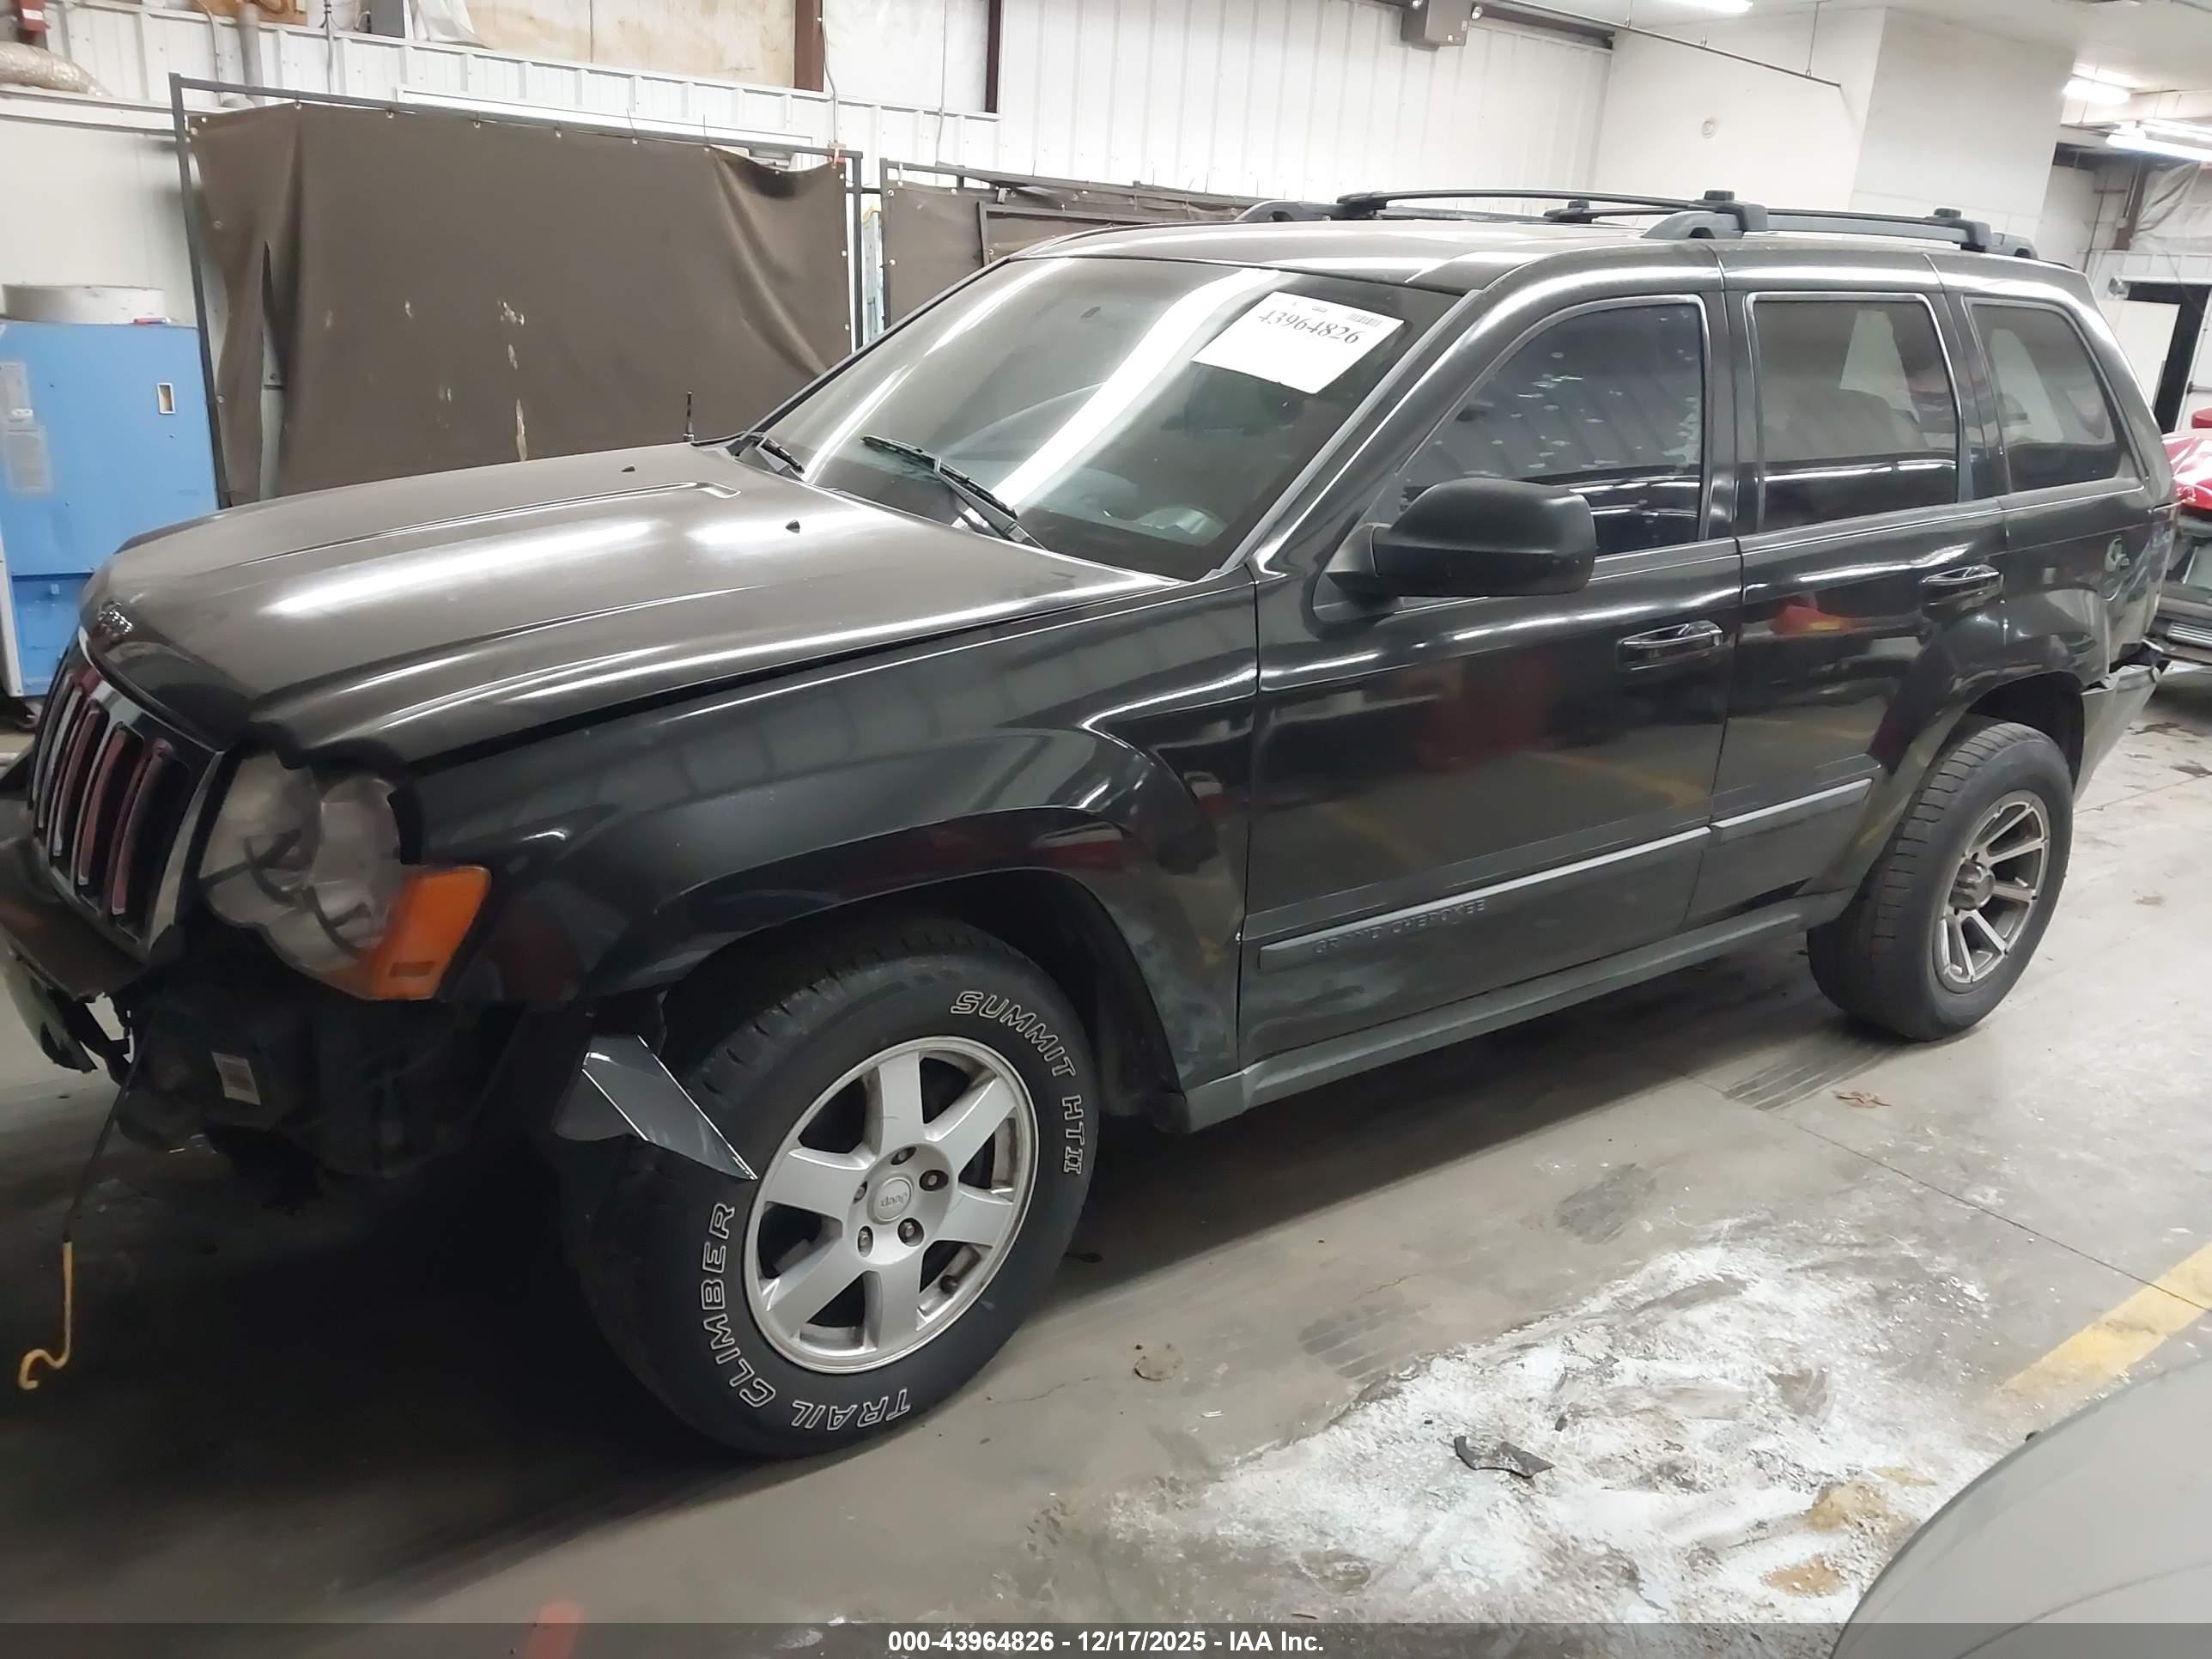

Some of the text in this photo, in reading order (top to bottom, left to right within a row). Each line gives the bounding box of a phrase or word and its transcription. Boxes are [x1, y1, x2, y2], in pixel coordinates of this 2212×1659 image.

[1258, 310, 1367, 343] 43964826
[1315, 926, 1383, 954] GRD
[950, 990, 1076, 1077] SUMMIT
[701, 1202, 911, 1431] TRAIL CLIMBER
